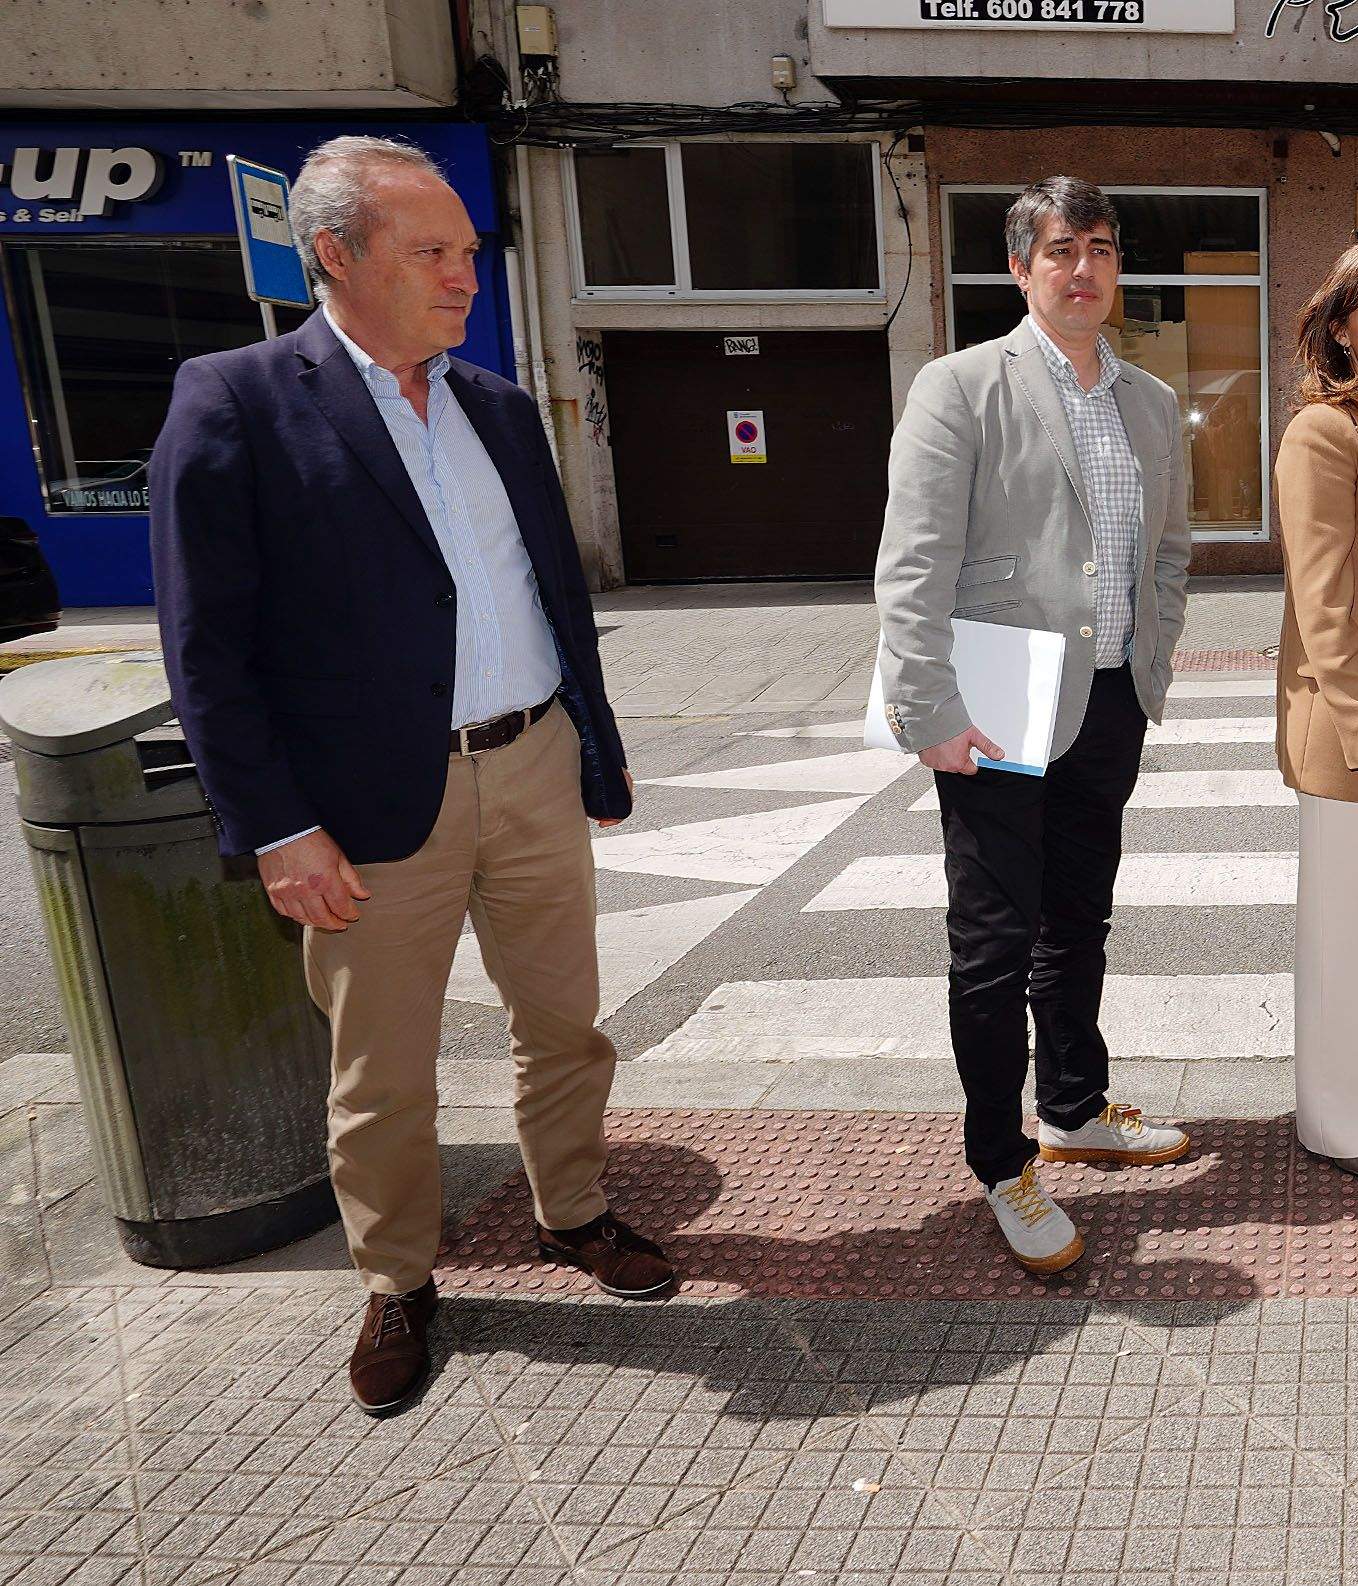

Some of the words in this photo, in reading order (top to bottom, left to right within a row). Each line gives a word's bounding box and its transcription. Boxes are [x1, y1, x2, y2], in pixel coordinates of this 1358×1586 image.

[924, 0, 979, 17] Telf.
[986, 0, 1033, 19] 600
[1040, 0, 1084, 20] 841
[1094, 1, 1139, 21] 778
[13, 208, 32, 222] &
